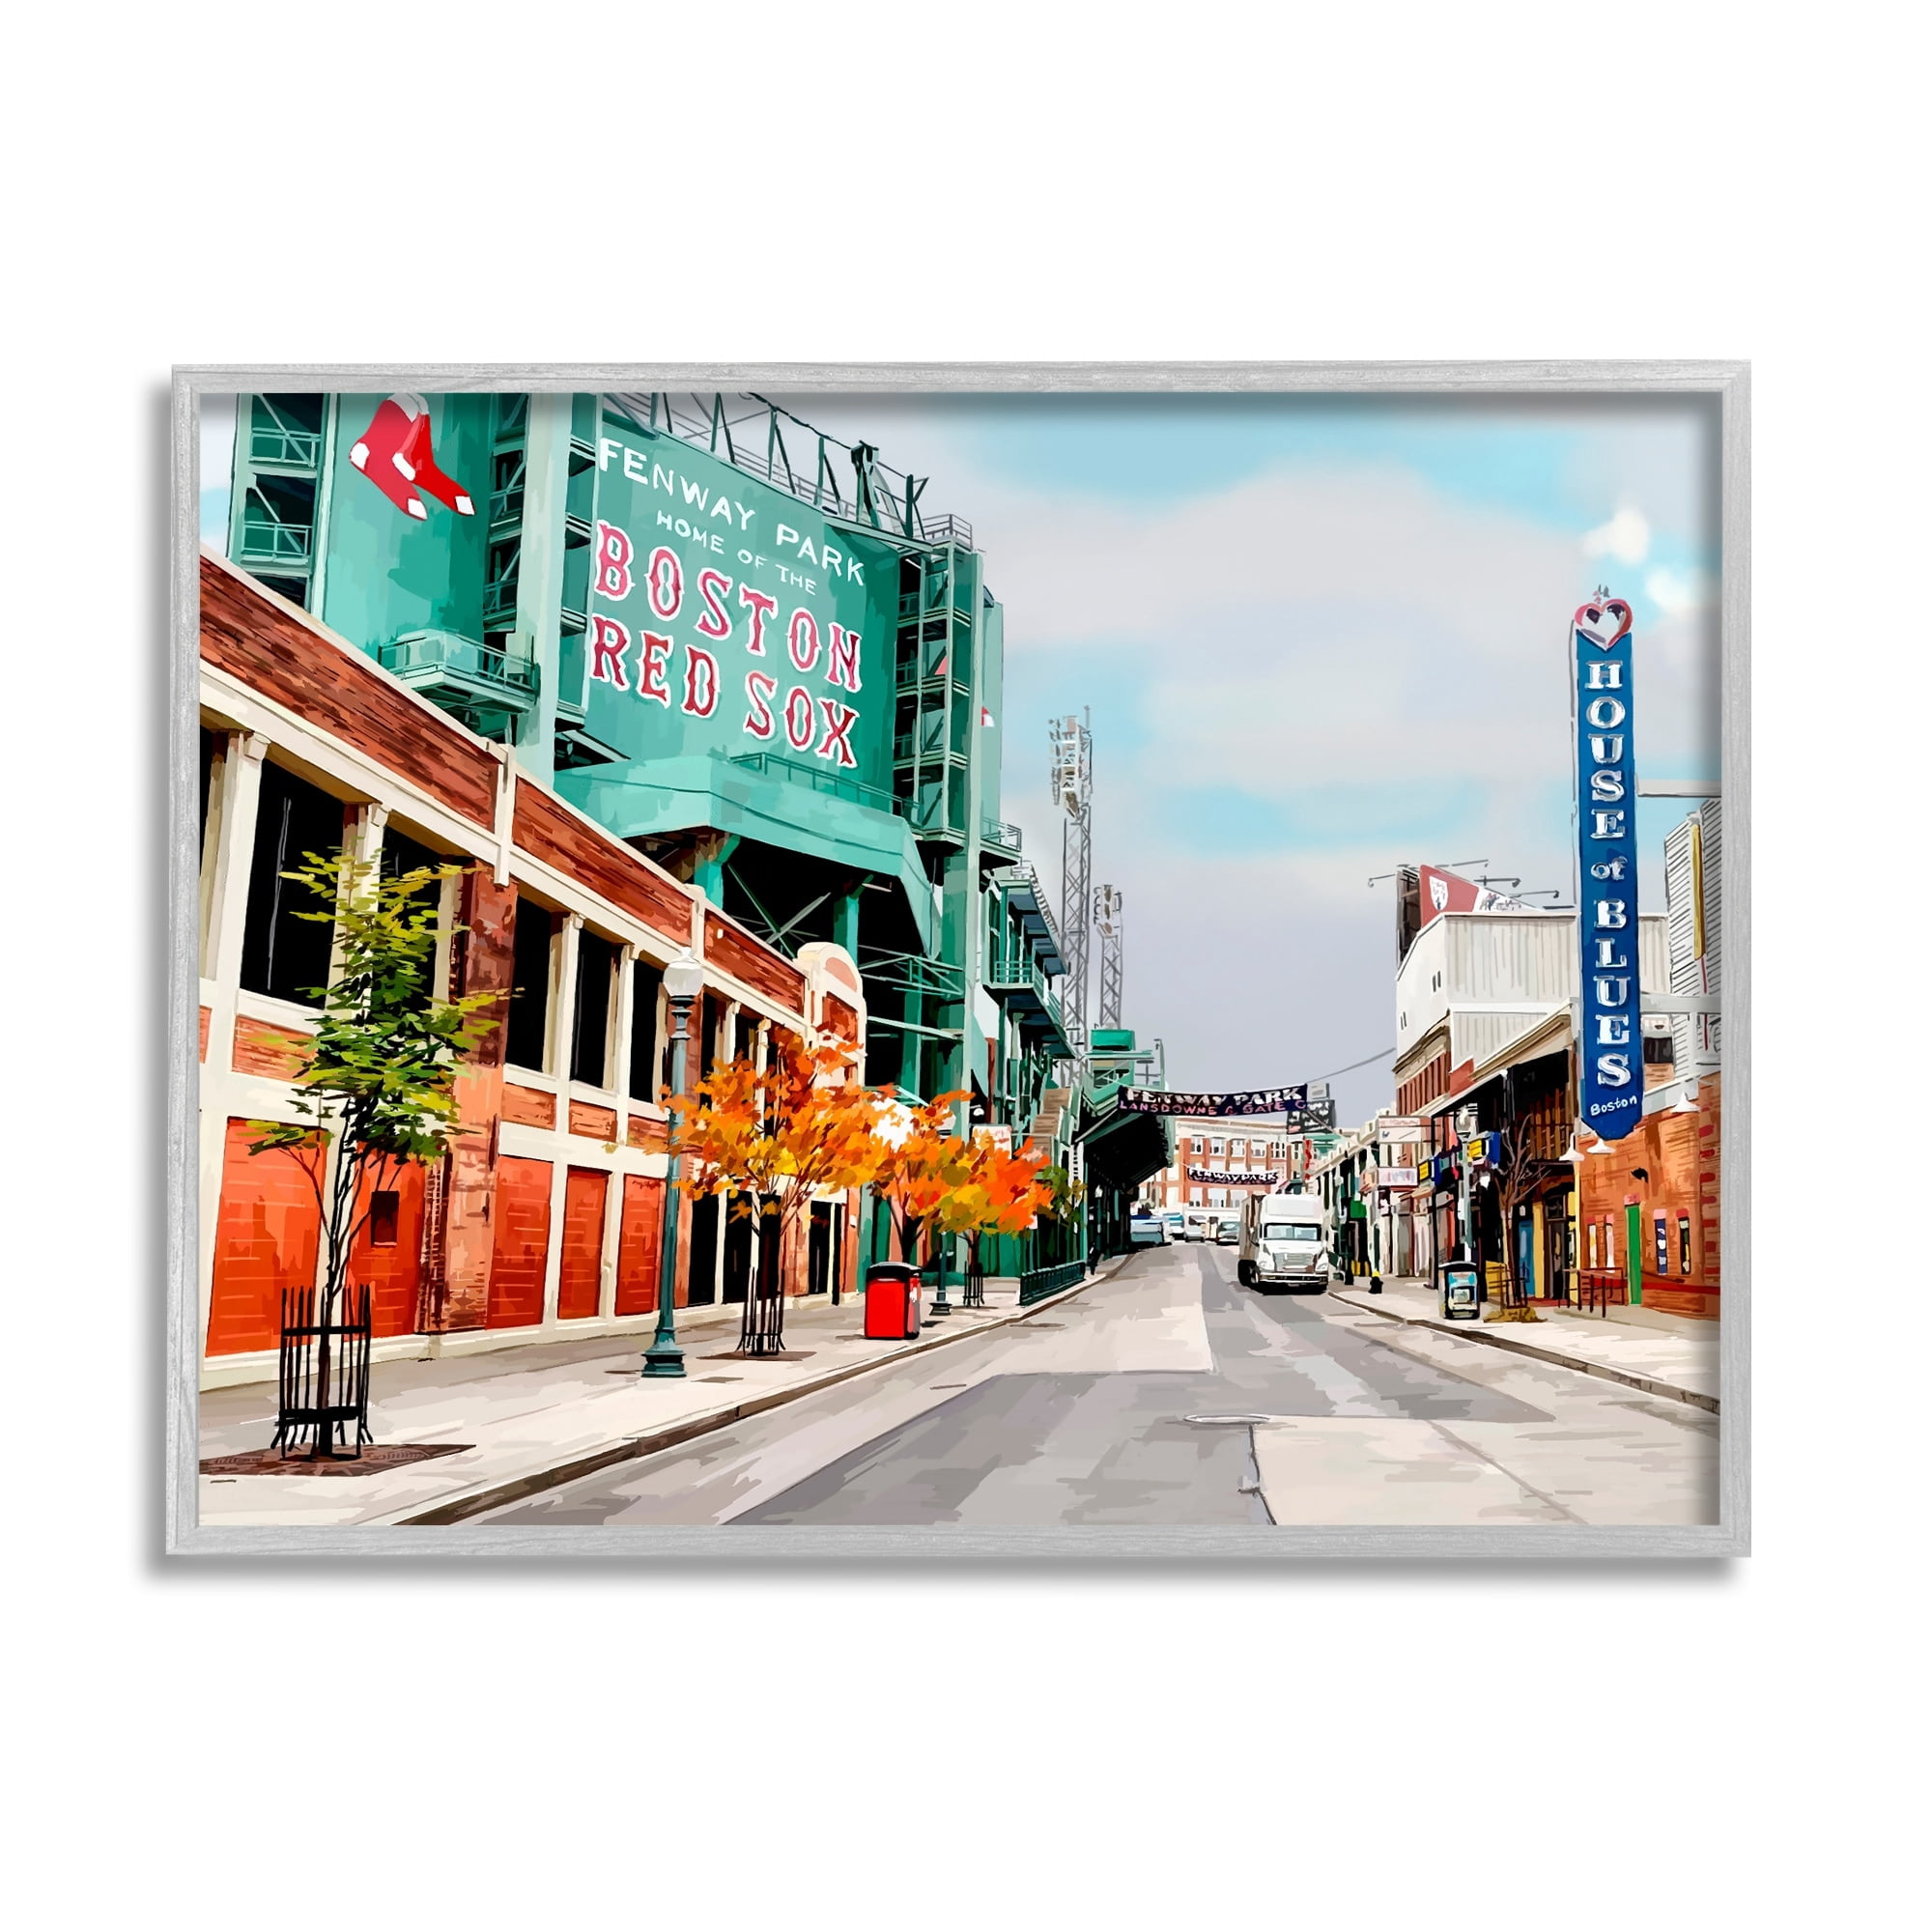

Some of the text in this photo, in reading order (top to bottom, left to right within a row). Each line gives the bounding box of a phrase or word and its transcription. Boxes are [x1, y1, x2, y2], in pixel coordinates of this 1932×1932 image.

[600, 438, 865, 585] FENWAY PARK
[657, 510, 817, 595] HOME OF THE
[594, 520, 862, 692] BOSTON
[590, 612, 861, 768] RED SOX
[1584, 660, 1626, 838] HOUSE
[1593, 898, 1632, 1087] BLUES
[1120, 1100, 1217, 1116] LANSDOWNE
[1242, 1101, 1286, 1114] GATE
[1126, 1087, 1302, 1107] FENWAY PARK
[1590, 1094, 1637, 1116] Boston
